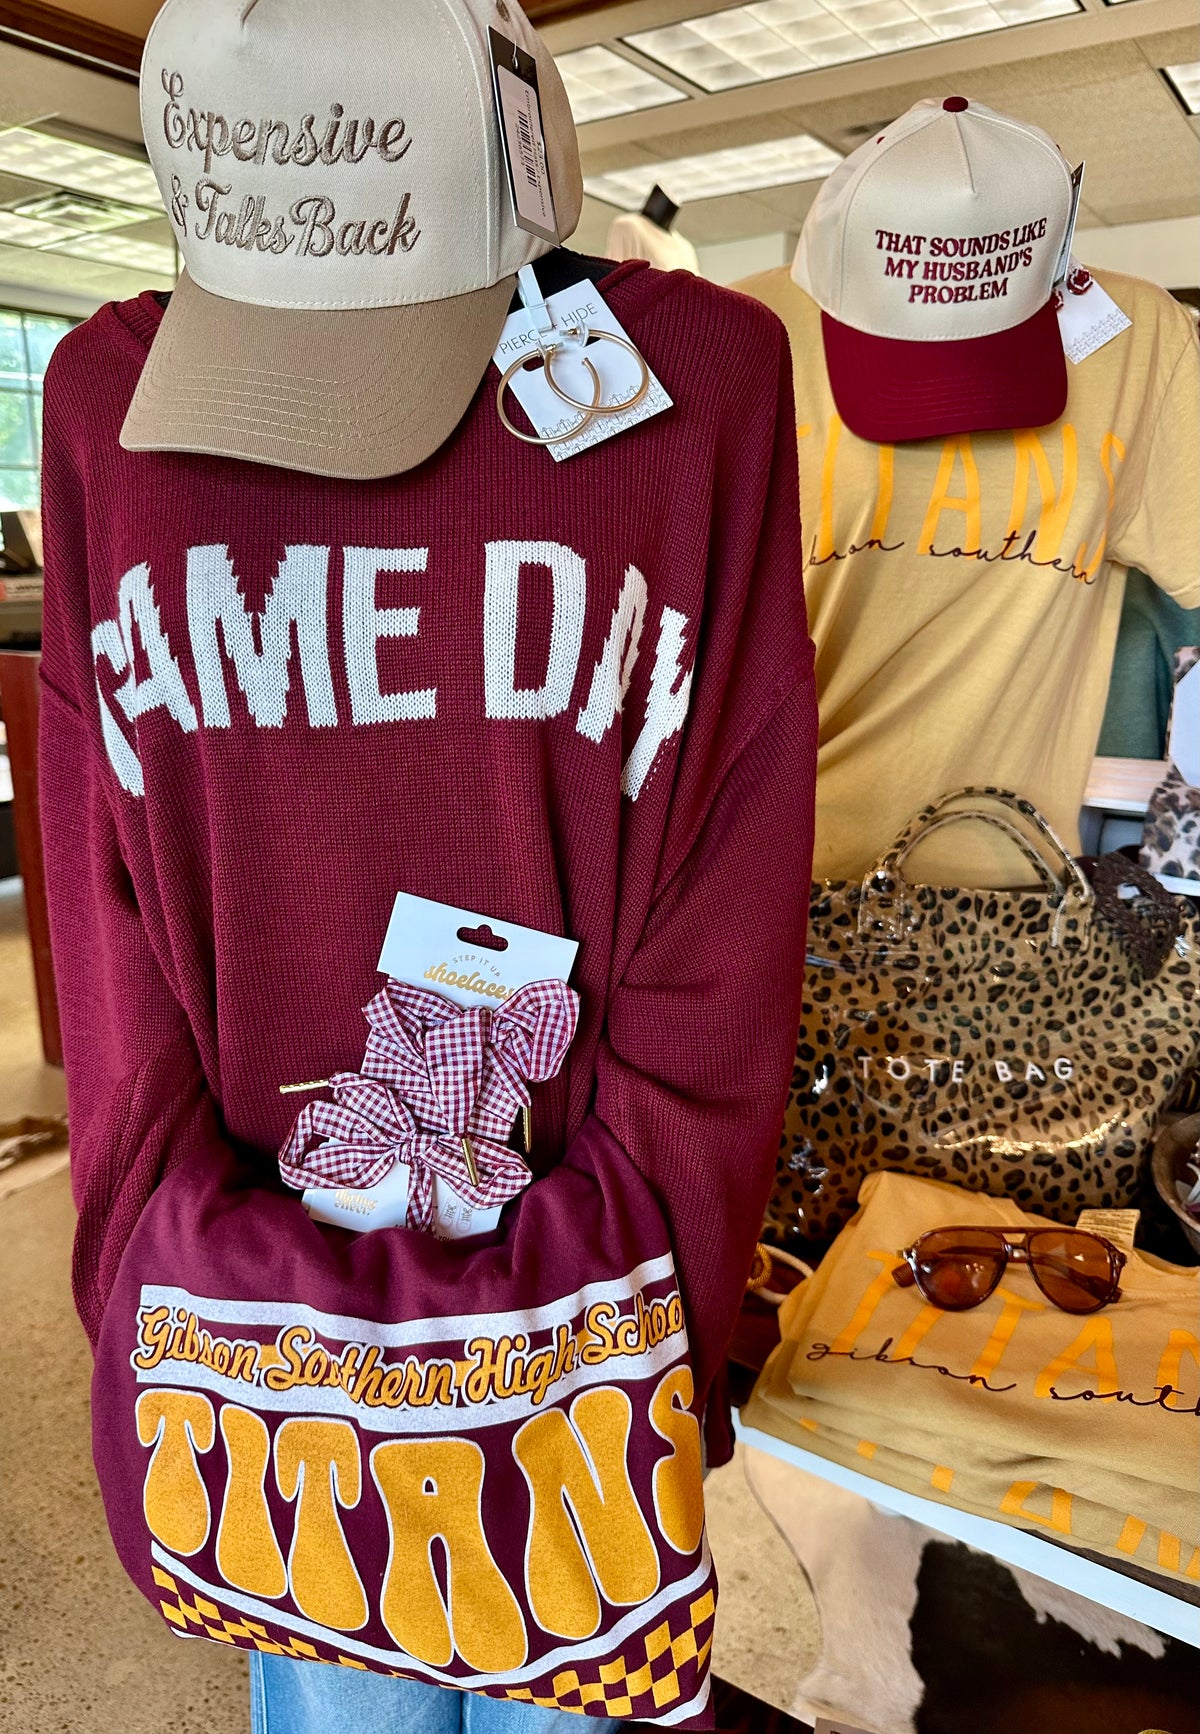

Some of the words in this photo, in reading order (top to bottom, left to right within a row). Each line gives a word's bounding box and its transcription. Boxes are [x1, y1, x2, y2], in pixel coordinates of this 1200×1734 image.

[162, 68, 412, 173] Expensive
[171, 174, 188, 236] &
[195, 178, 295, 254] Talks
[289, 192, 421, 257] Back
[875, 229, 926, 255] THAT
[929, 230, 1010, 257] SOUNDS
[1012, 217, 1047, 248] LIKE
[884, 257, 919, 279] MY
[922, 247, 1033, 281] HUSBAND'S
[907, 277, 1008, 304] PROBLEM
[561, 302, 598, 327] HIDE
[803, 534, 904, 572] bson
[928, 530, 1096, 585] southern
[92, 543, 437, 797] GAME
[453, 954, 476, 964] STEP
[480, 957, 489, 966] IT
[490, 965, 501, 977] UP
[858, 1056, 964, 1082] TOTE
[995, 1057, 1073, 1081] BAG
[133, 1304, 258, 1382] Gibson
[466, 1324, 574, 1405] High
[806, 1337, 1017, 1392] gibson
[1049, 1385, 1200, 1417] sout
[135, 1365, 703, 1672] TITANS
